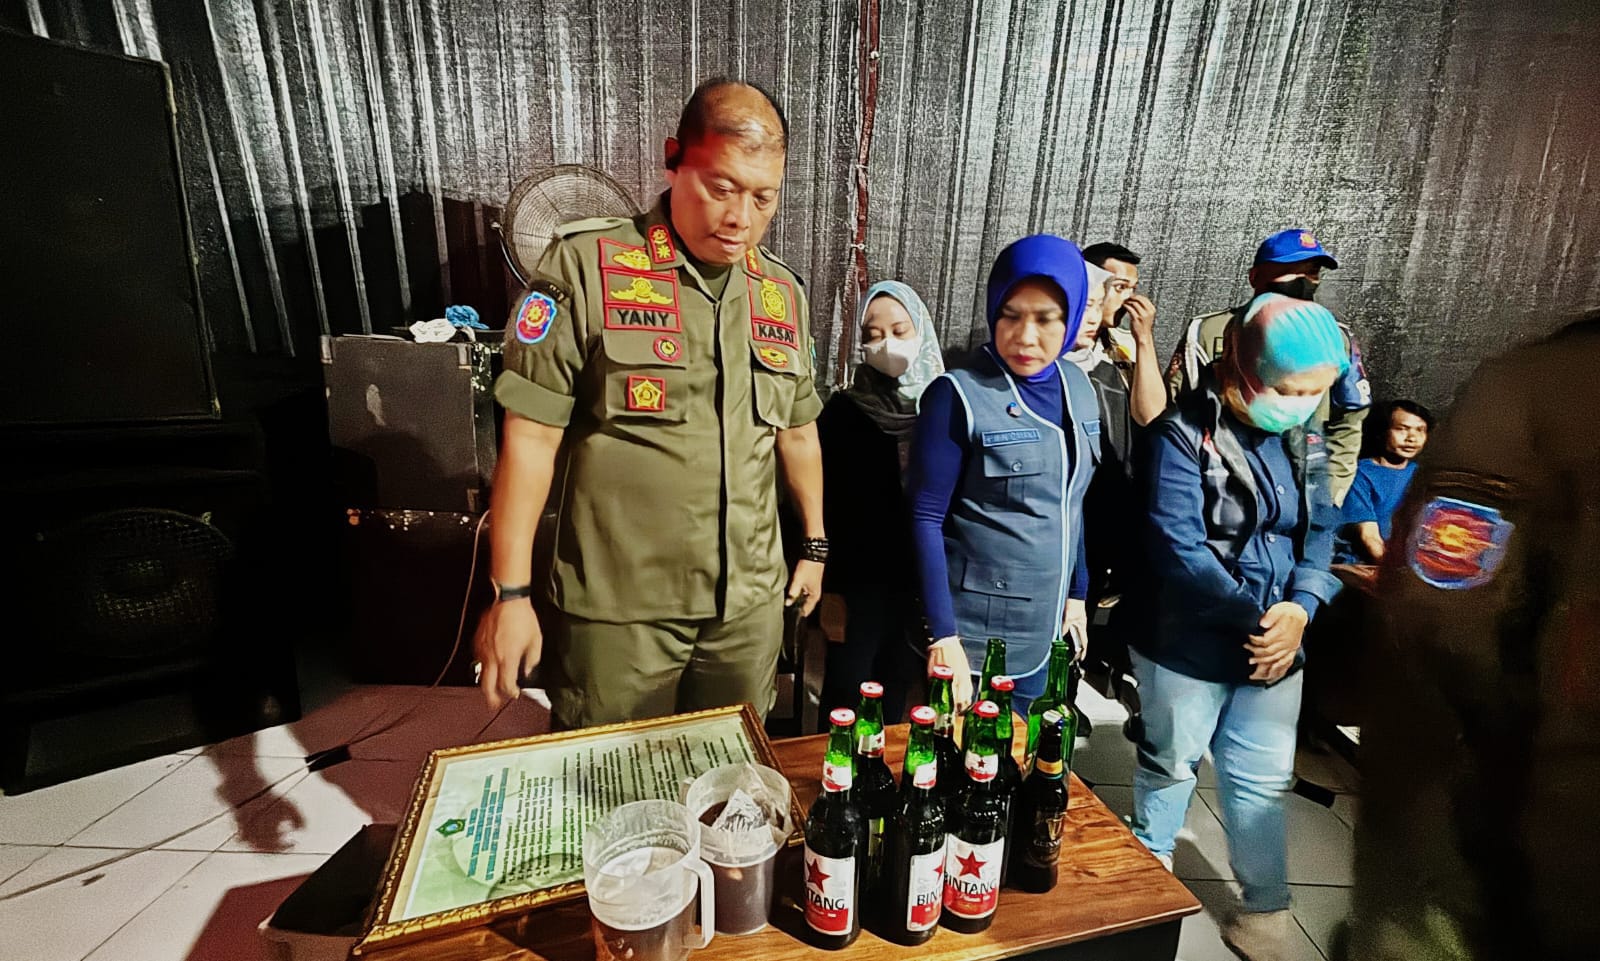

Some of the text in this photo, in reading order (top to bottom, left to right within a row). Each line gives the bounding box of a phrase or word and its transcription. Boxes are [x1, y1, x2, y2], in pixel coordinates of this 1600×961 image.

[617, 310, 669, 327] YANY
[808, 888, 845, 910] TANG
[917, 888, 939, 906] BIN
